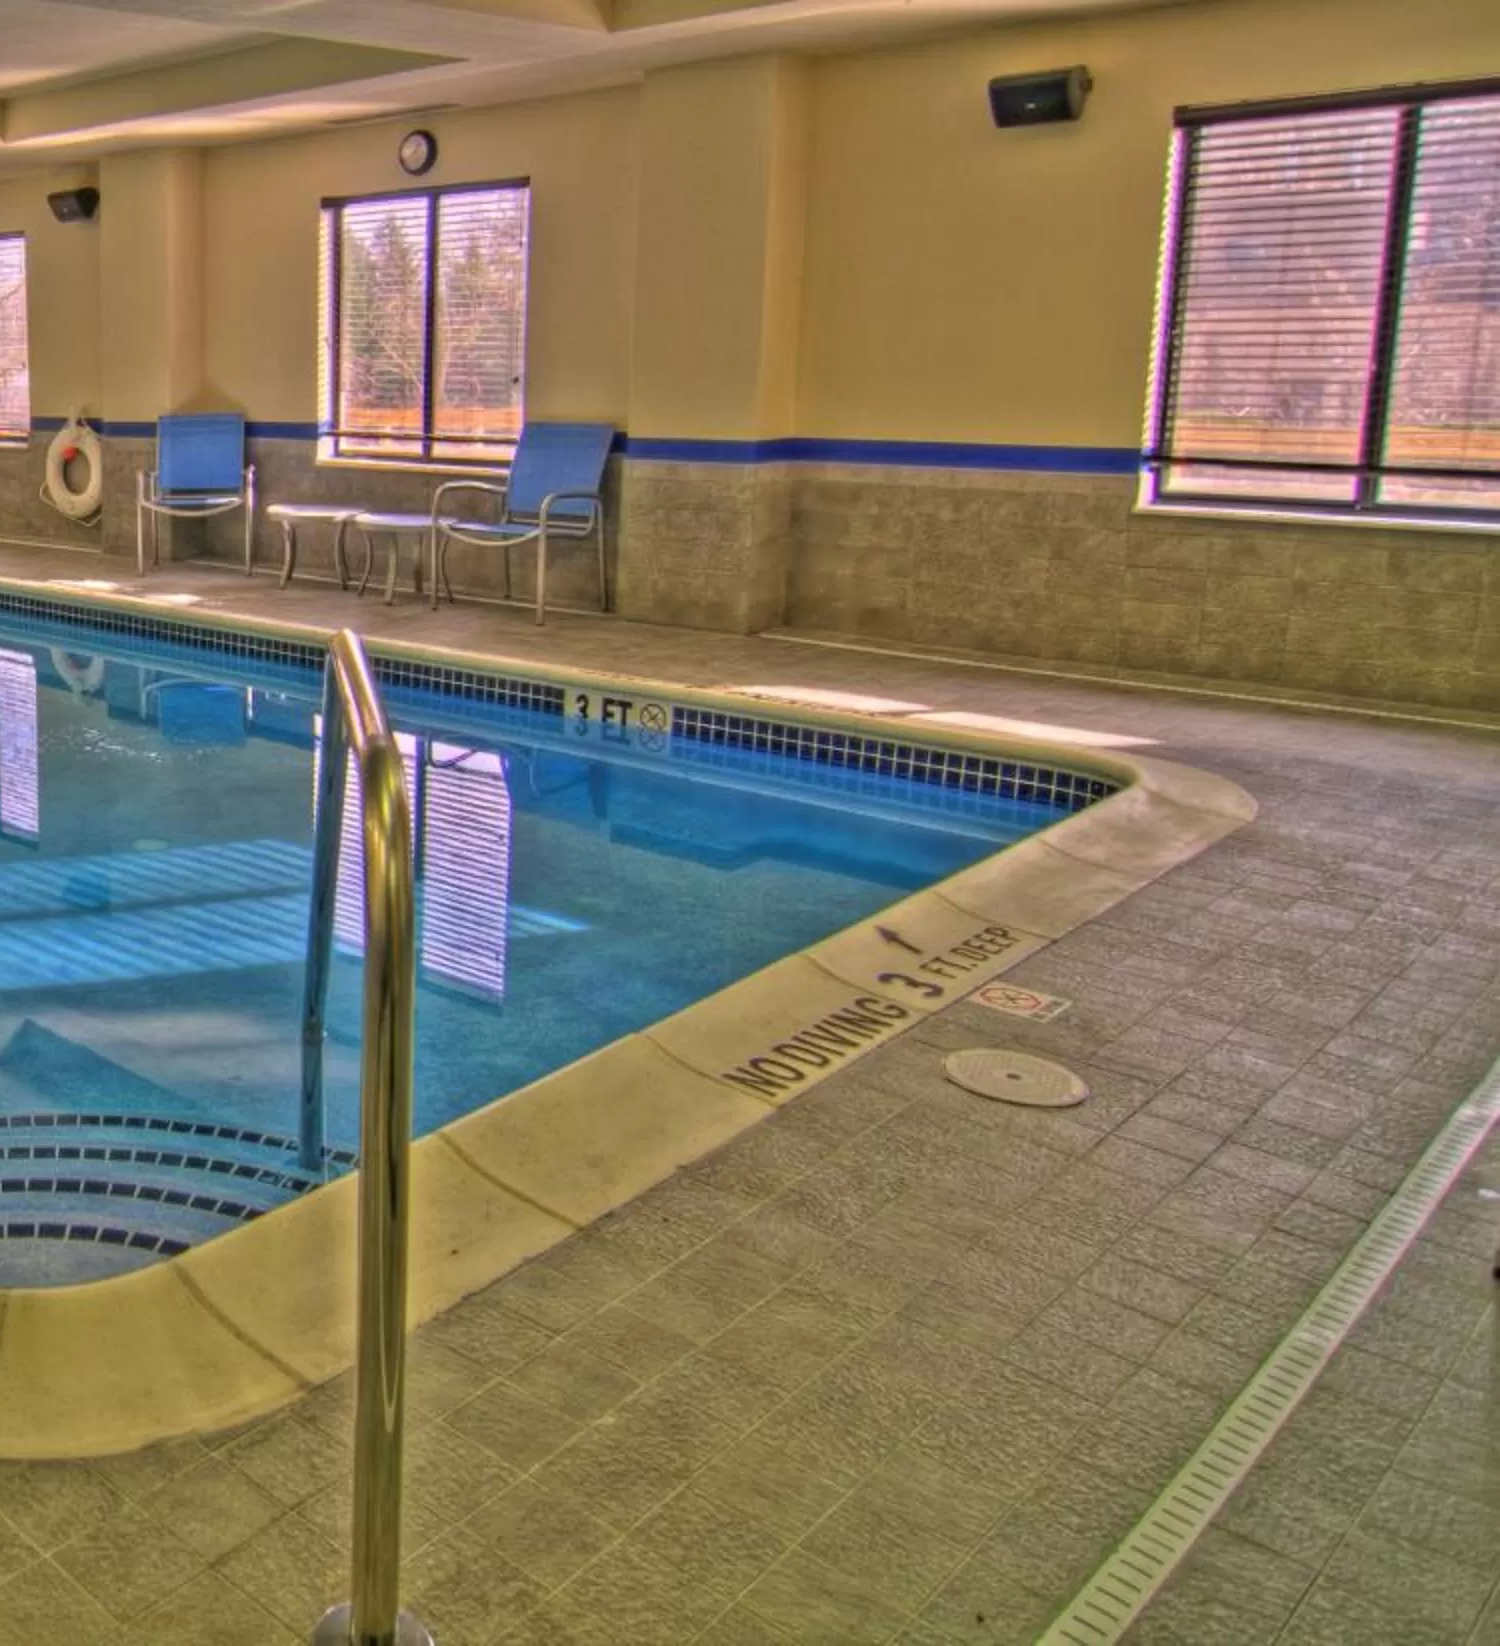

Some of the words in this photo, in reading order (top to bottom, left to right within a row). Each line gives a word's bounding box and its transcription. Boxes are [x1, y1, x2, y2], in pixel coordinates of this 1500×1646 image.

[575, 694, 589, 721] 3
[601, 697, 633, 725] FT
[721, 1056, 806, 1097] NO
[771, 996, 910, 1069] DIVING
[876, 972, 945, 997] 3
